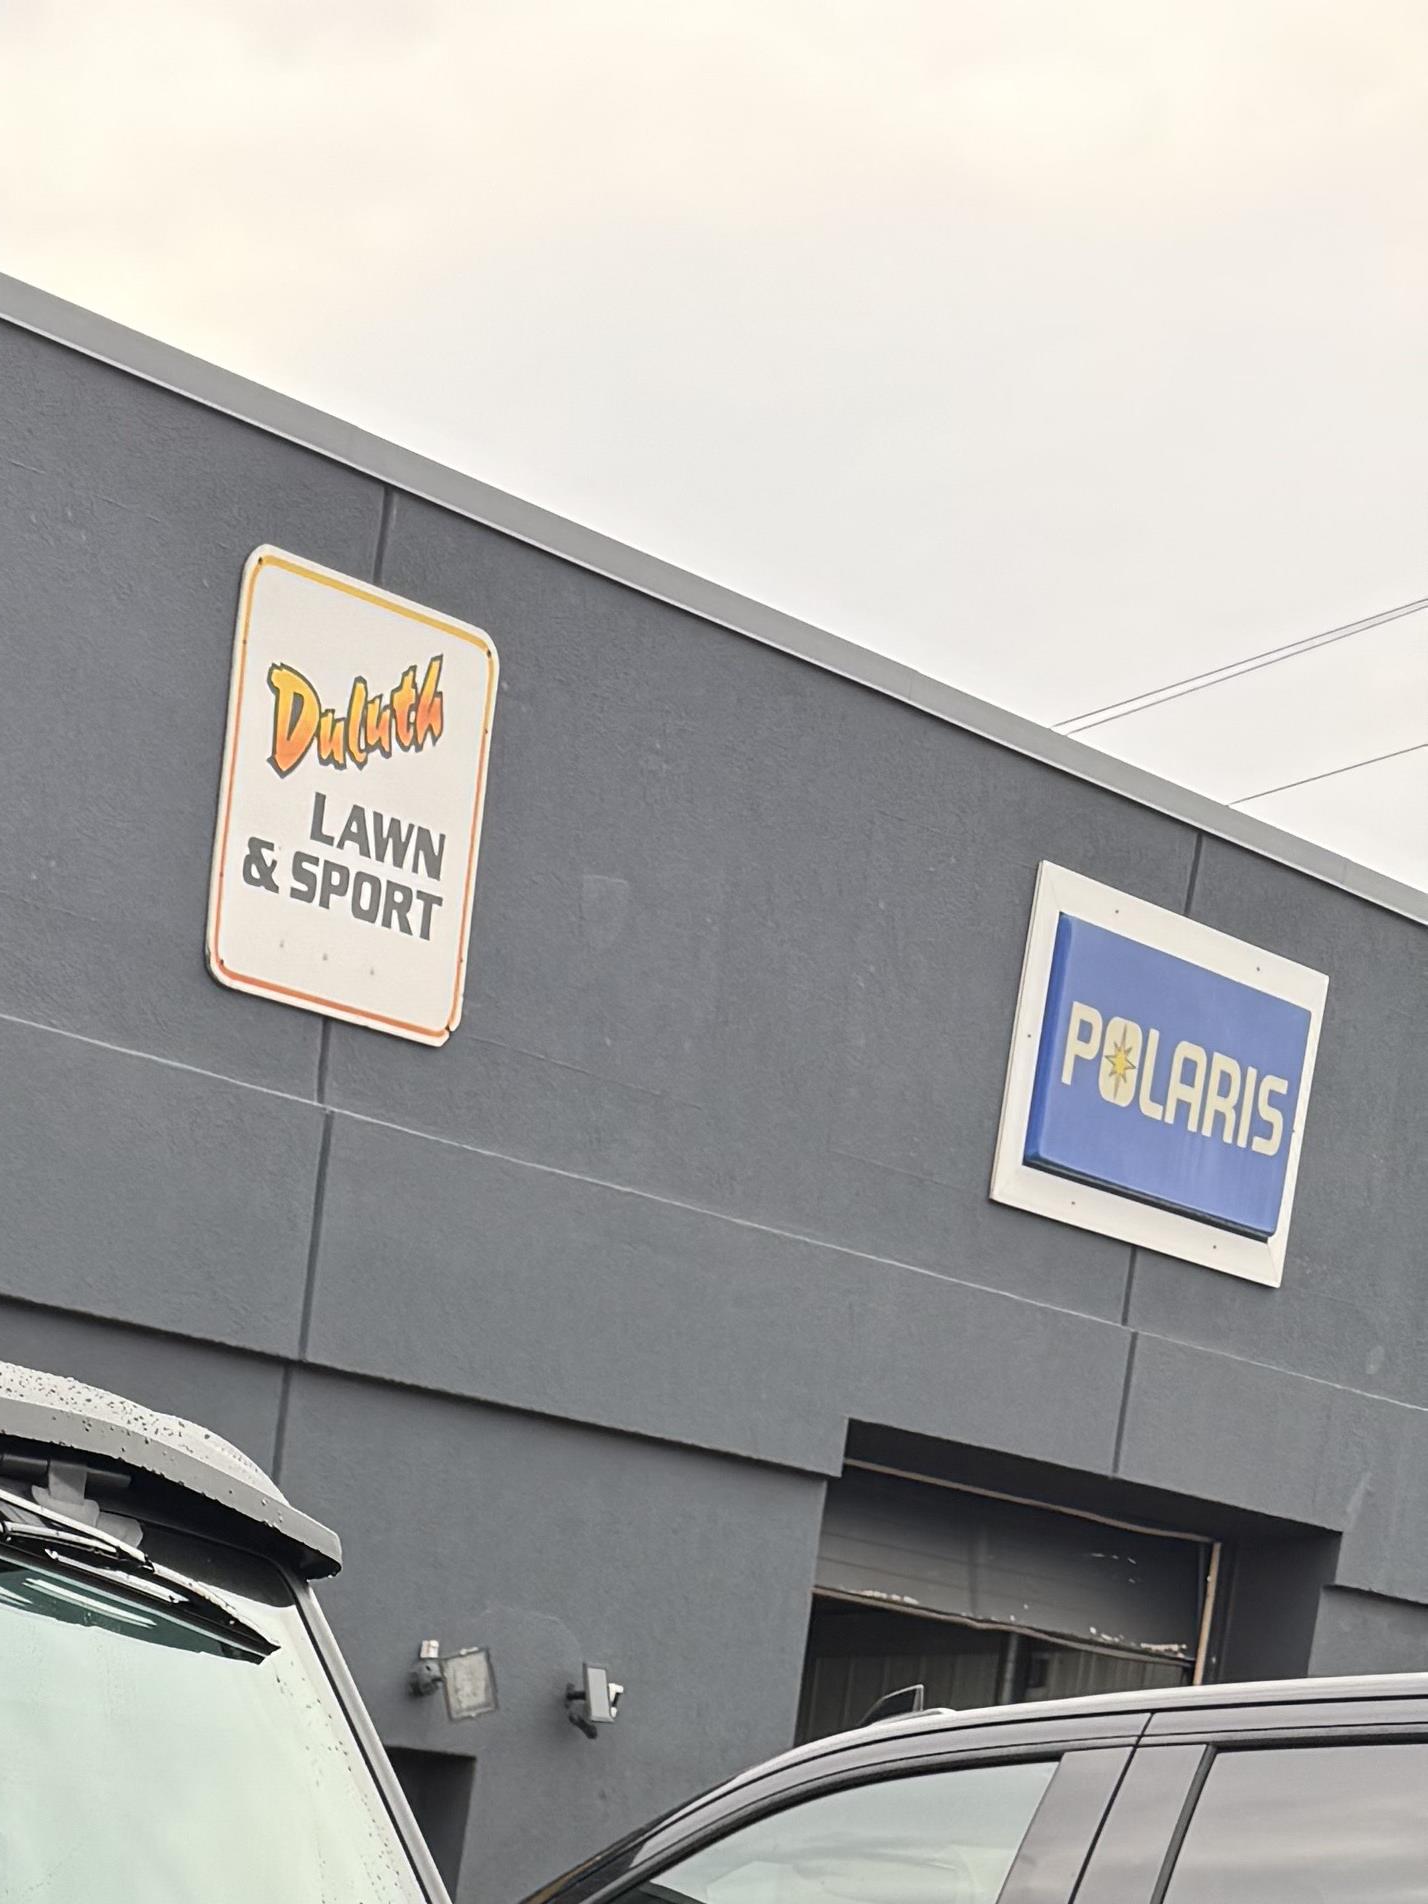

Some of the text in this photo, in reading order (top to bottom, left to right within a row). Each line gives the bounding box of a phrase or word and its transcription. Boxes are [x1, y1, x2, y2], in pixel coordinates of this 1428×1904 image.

[266, 654, 444, 778] Duluth
[242, 835, 443, 942] & SPORT
[310, 791, 446, 881] LAWN
[1061, 1000, 1289, 1157] POLARIS
